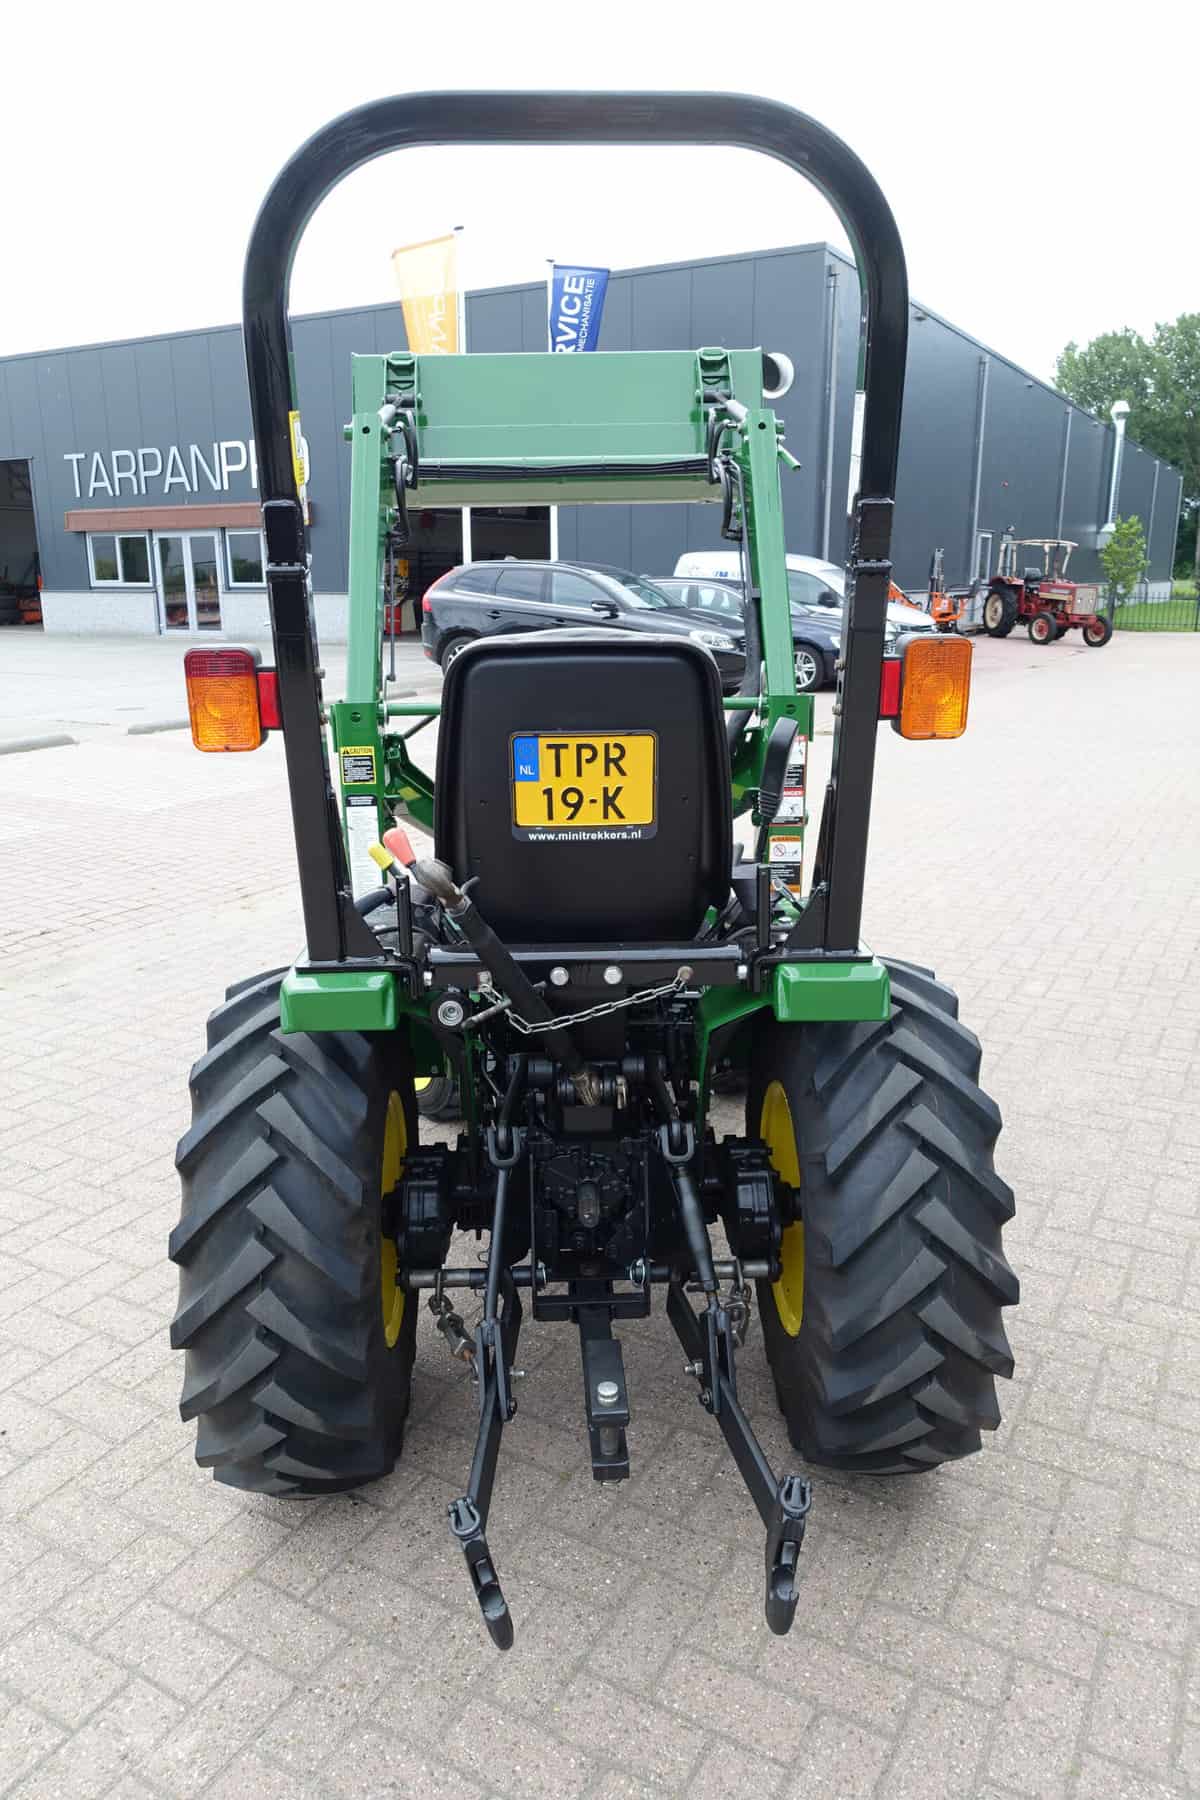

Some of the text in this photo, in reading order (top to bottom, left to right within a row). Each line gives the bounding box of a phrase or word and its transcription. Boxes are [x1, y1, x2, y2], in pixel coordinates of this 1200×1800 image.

[63, 437, 310, 498] TARPANP
[519, 765, 535, 775] NL
[546, 742, 627, 777] TPR
[541, 785, 626, 821] 19-K
